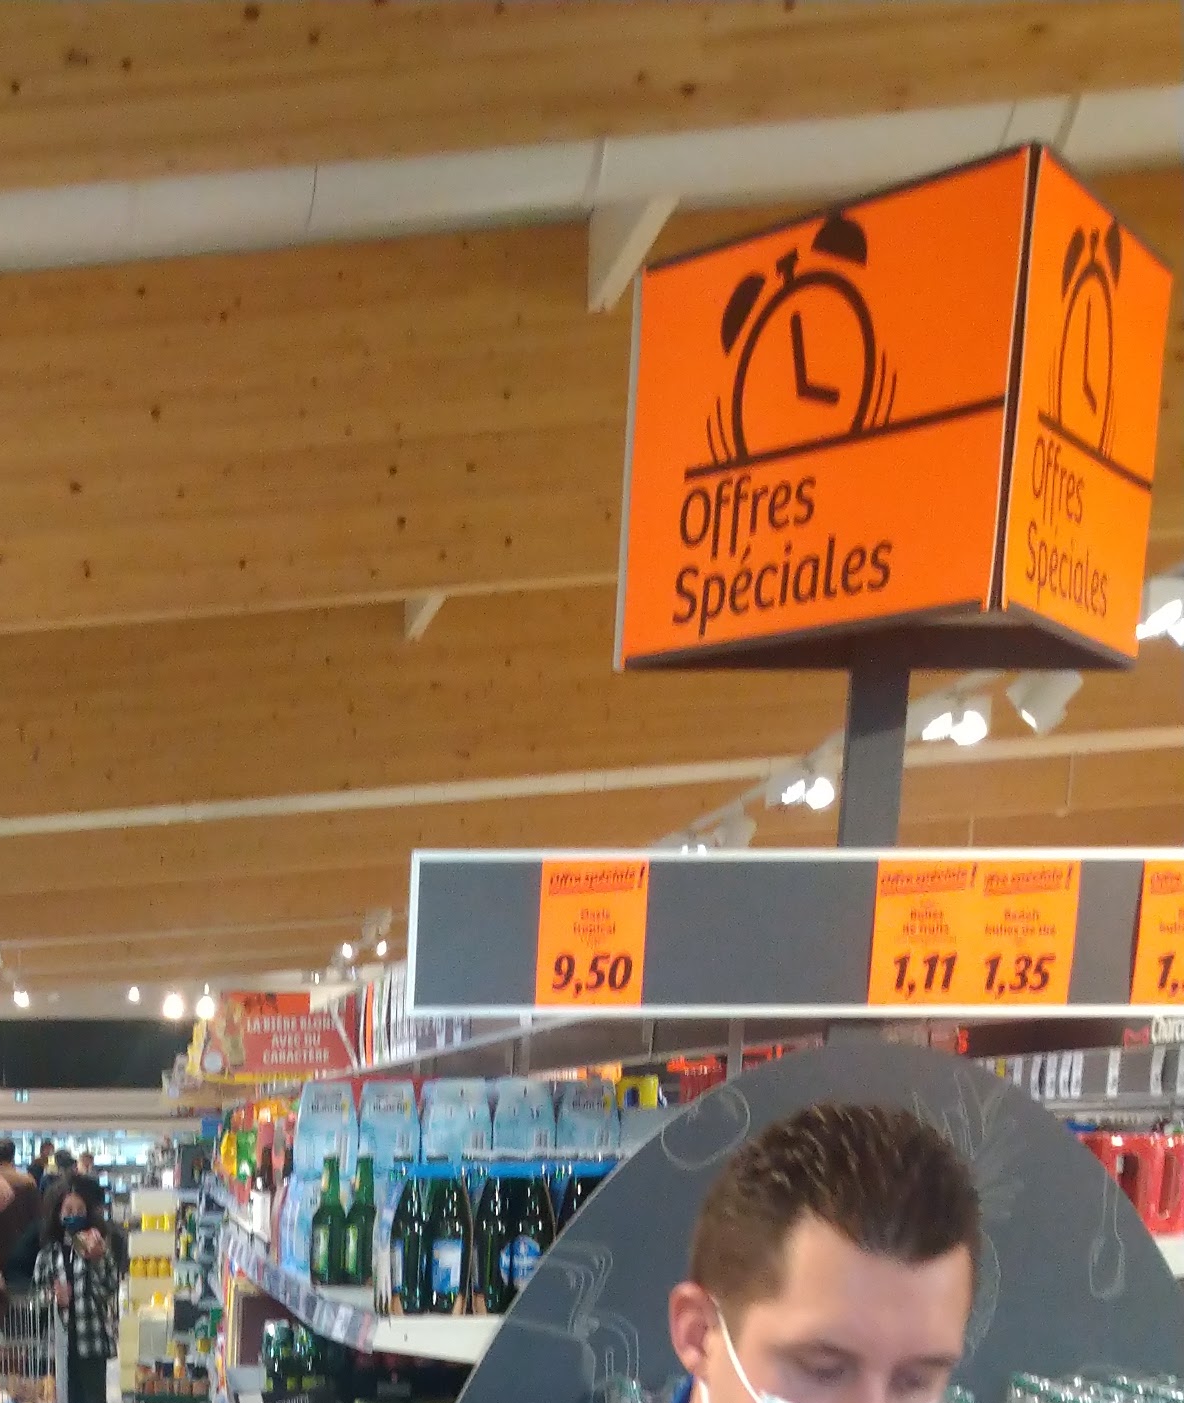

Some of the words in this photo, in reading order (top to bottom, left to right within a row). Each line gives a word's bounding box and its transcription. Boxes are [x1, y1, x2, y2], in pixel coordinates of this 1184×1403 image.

[1031, 435, 1084, 525] Offres
[679, 474, 817, 560] Offres
[671, 537, 893, 637] Spéciales
[1025, 520, 1109, 618] Spéciales
[551, 953, 634, 999] 9,50
[893, 951, 958, 999] 1,11
[984, 951, 1057, 999] 1,35
[1157, 952, 1184, 998] 1,
